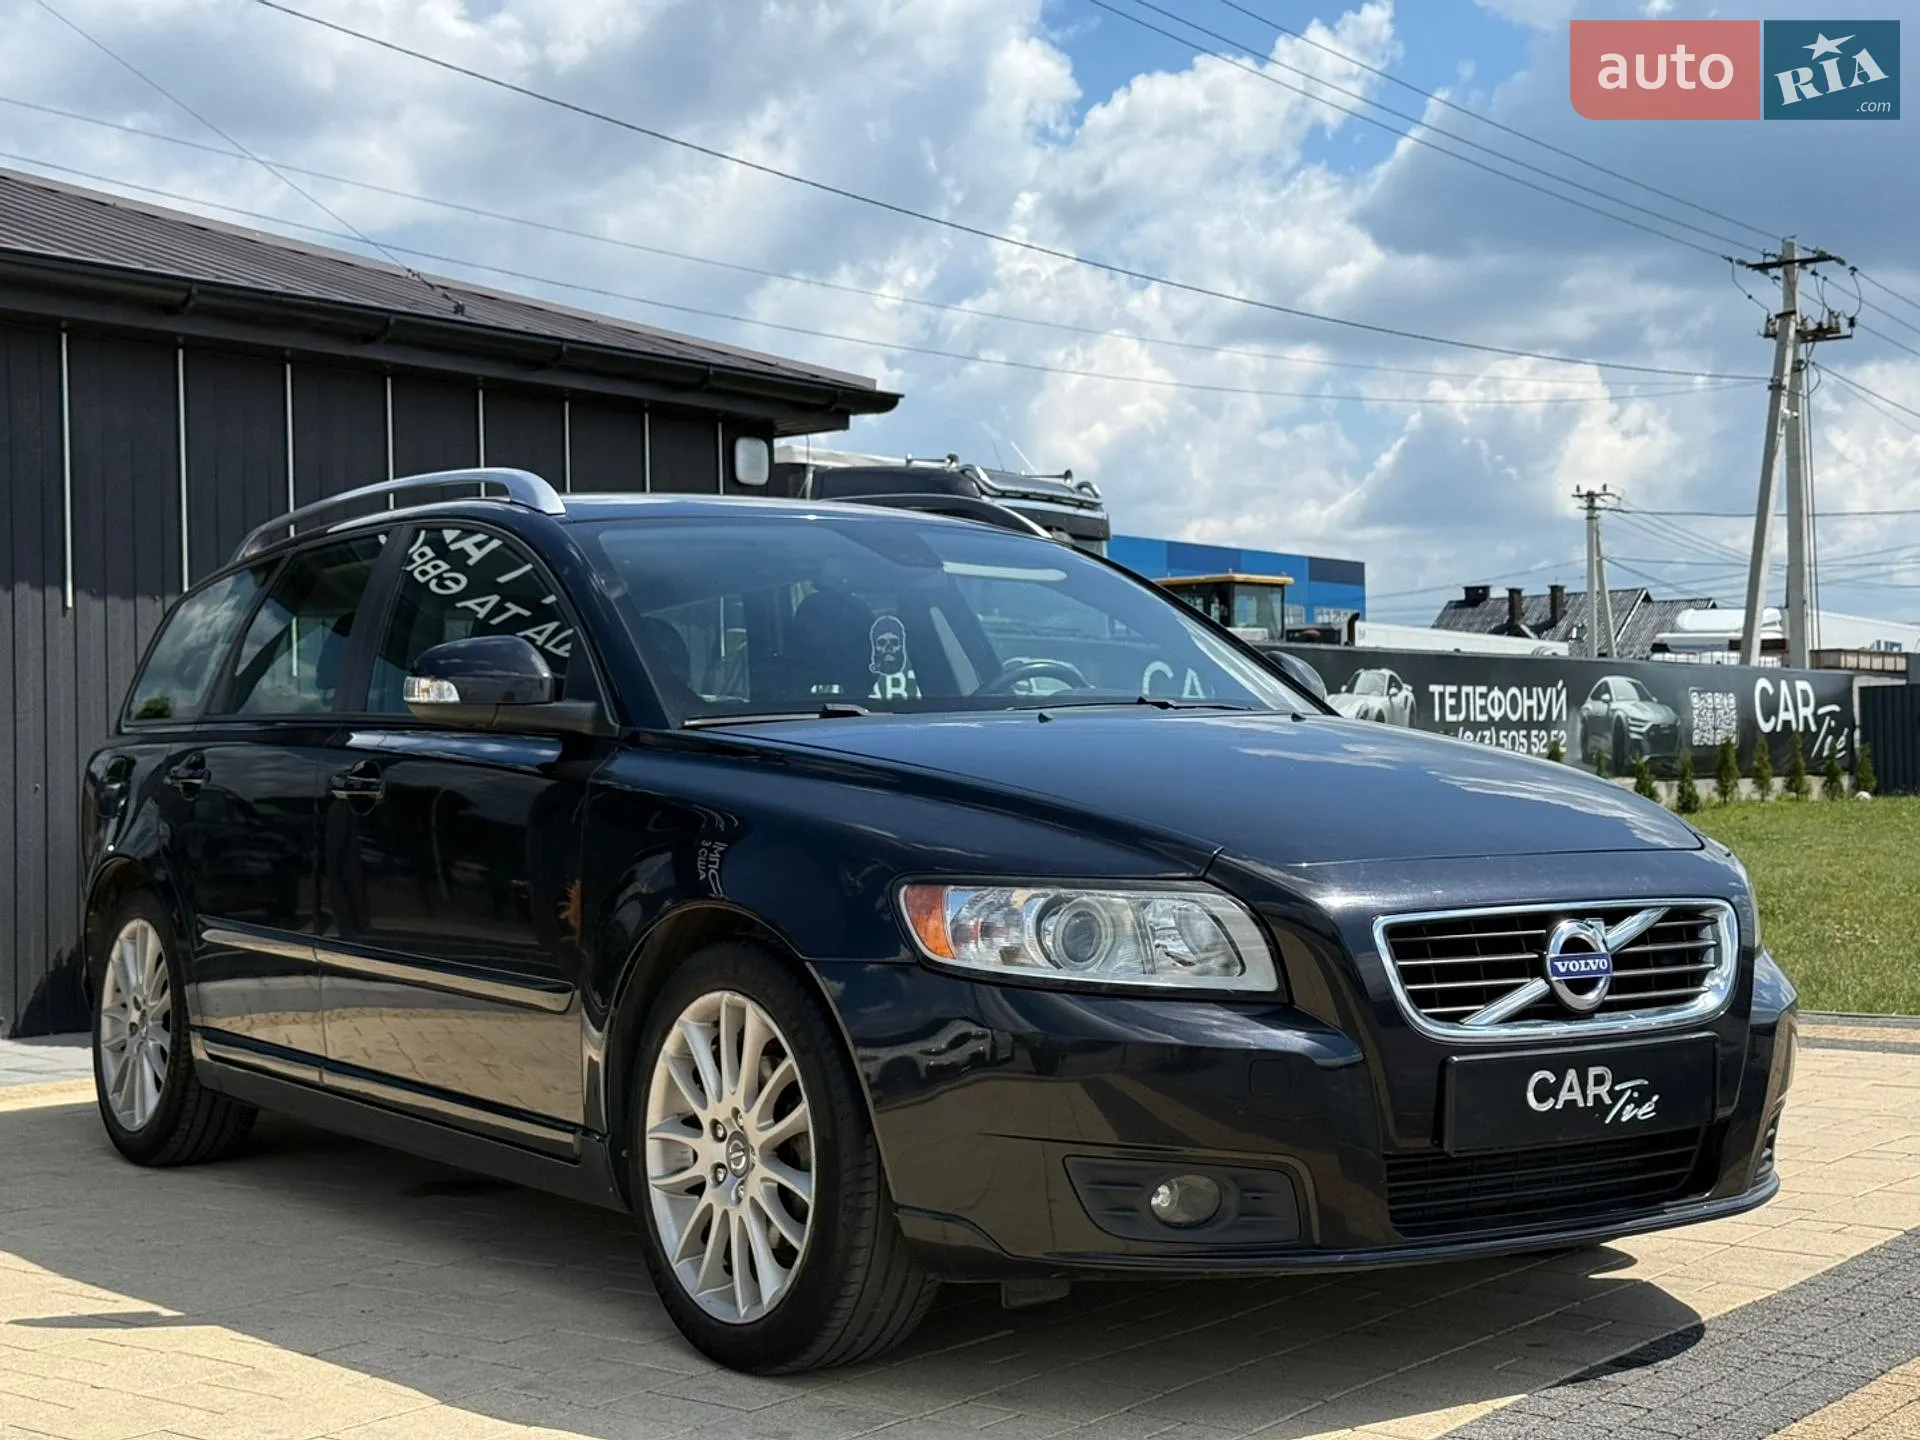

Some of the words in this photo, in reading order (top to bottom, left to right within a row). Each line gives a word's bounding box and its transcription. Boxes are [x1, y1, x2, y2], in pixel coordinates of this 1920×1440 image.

[1428, 679, 1567, 721] ТЕЛЕФОНУЙ
[1754, 677, 1817, 733] CAR
[1530, 730, 1548, 754] 52
[1554, 958, 1608, 973] VOLVO
[1526, 1066, 1612, 1112] CAR
